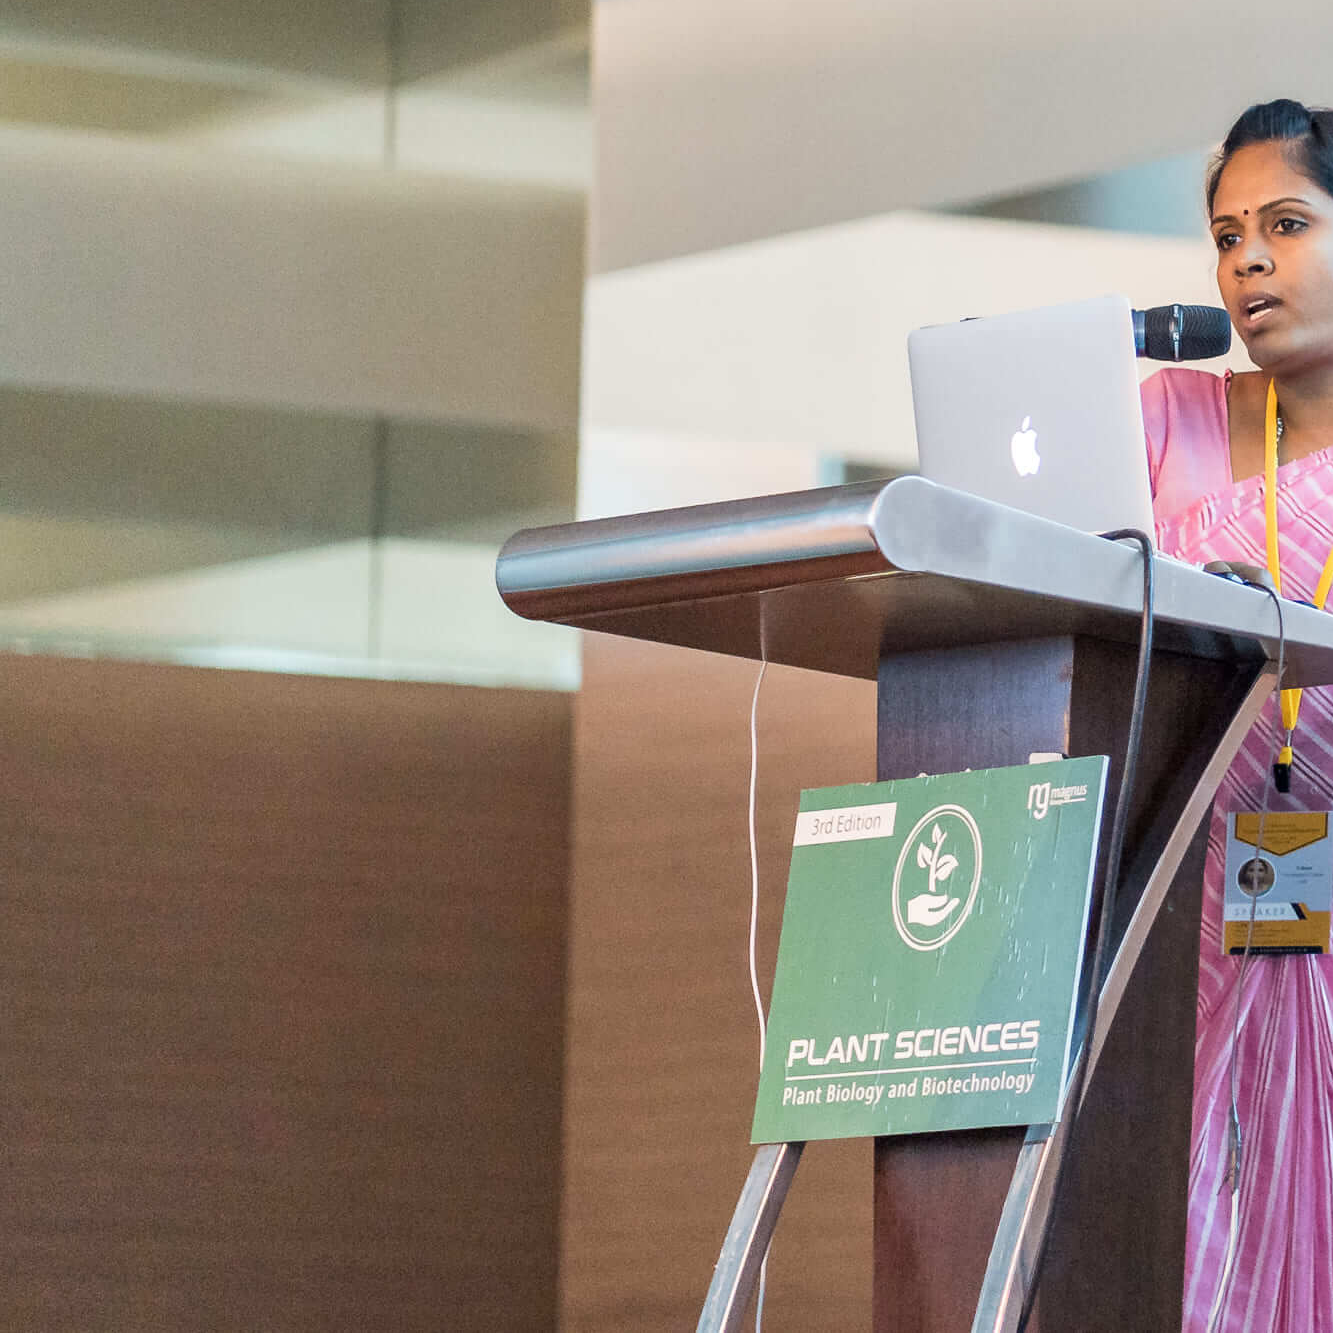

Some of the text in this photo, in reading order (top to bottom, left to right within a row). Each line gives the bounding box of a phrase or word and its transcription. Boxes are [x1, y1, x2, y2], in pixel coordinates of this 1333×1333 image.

[810, 812, 882, 837] 3rd Edition
[1234, 907, 1286, 916] SPAKER
[786, 1020, 1040, 1068] PLANT SCIENCES
[782, 1071, 1036, 1106] Plant Biology and Biotechnology
